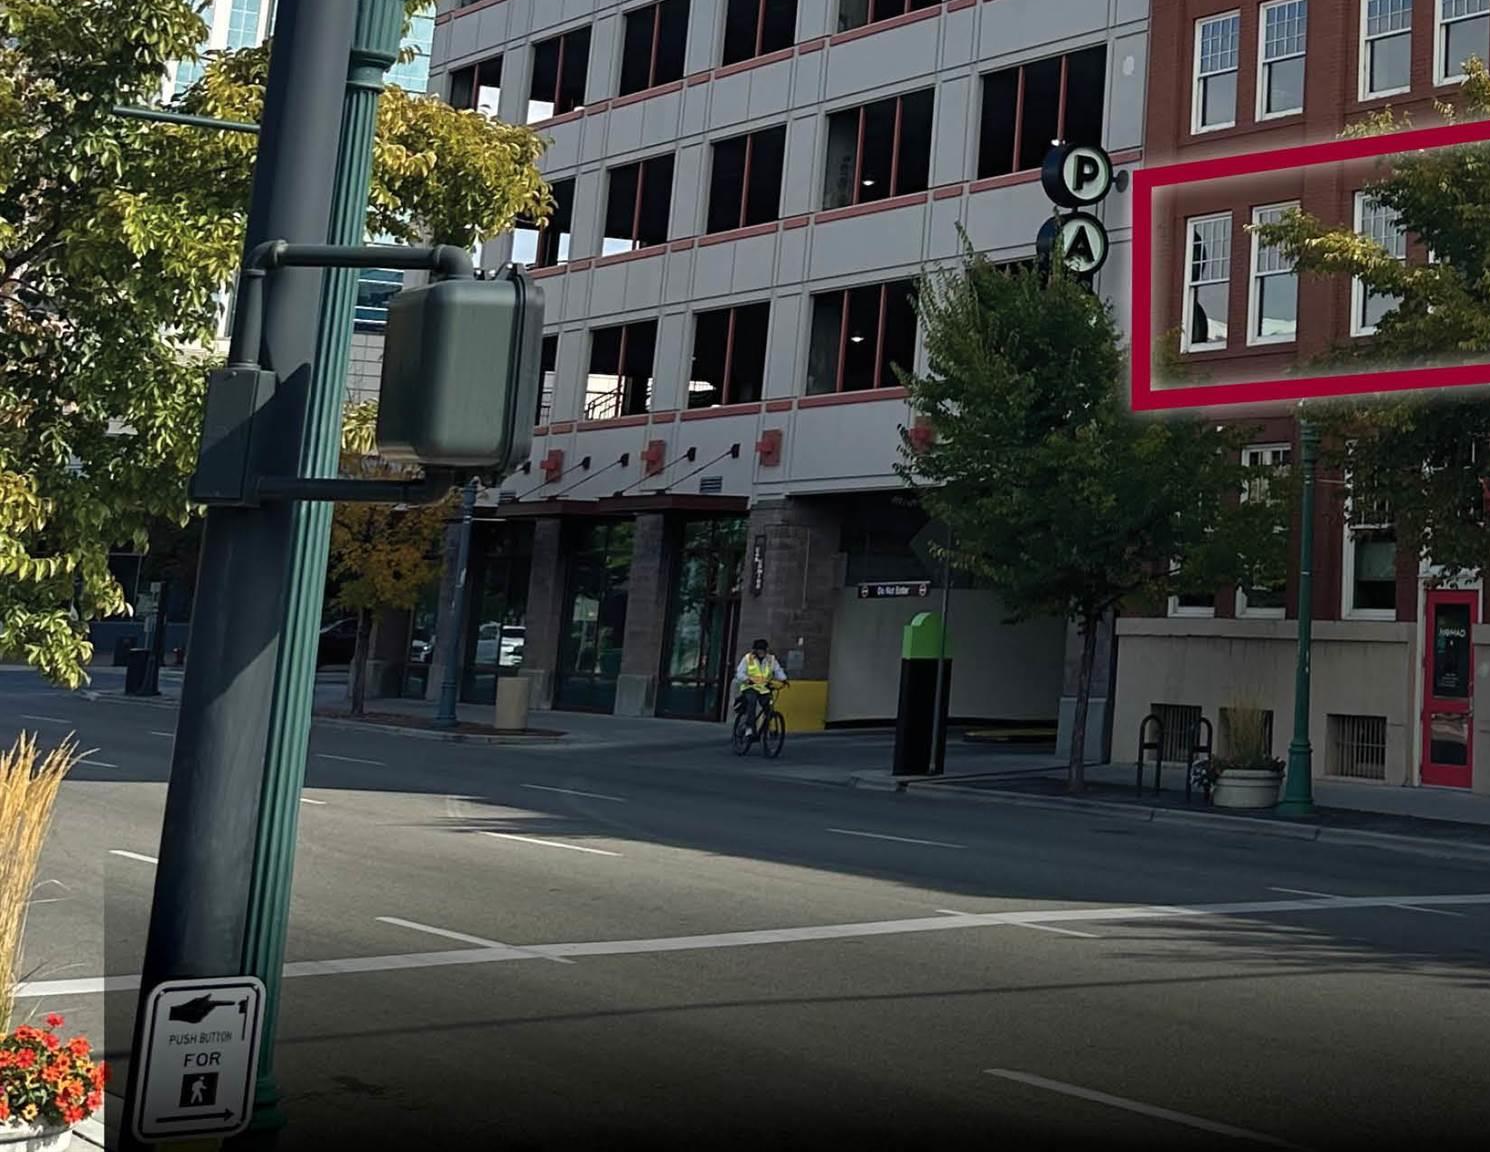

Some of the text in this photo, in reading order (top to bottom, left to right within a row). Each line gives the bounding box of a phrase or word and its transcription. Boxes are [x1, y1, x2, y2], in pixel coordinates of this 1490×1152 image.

[168, 1032, 233, 1046] PUSH BUTTON
[183, 1051, 222, 1067] FOR
